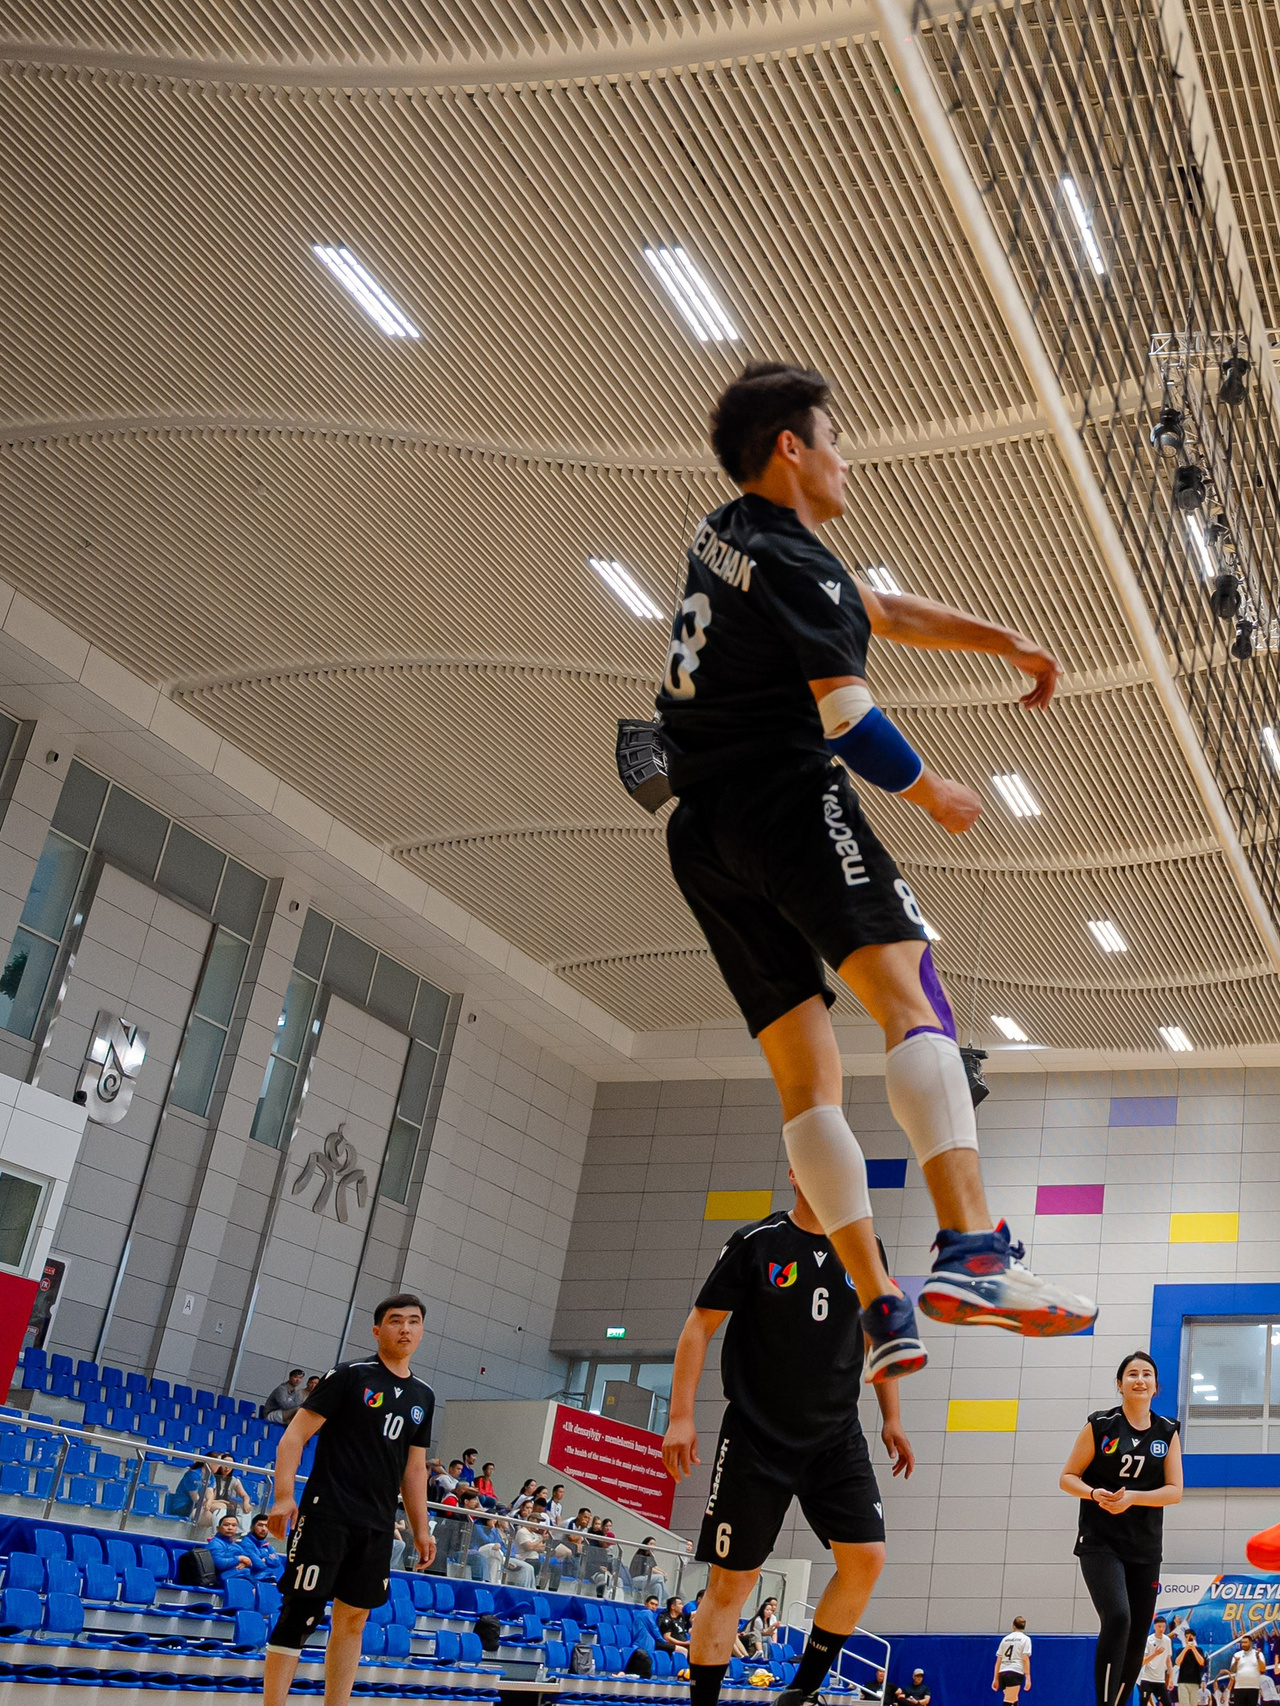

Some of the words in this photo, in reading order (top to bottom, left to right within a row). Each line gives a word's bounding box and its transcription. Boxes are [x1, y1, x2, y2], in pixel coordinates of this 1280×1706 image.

[664, 592, 712, 700] 8
[893, 878, 923, 925] 8
[185, 1300, 191, 1310] A
[811, 1287, 829, 1321] 6
[383, 1412, 404, 1440] 10
[413, 1408, 423, 1422] BI
[1154, 1443, 1164, 1454] BI
[1119, 1454, 1145, 1478] 27
[715, 1522, 732, 1558] 6
[294, 1564, 320, 1591] 10
[1164, 1584, 1200, 1594] GROUP
[1222, 1602, 1244, 1621] BI
[1004, 1645, 1014, 1661] 4
